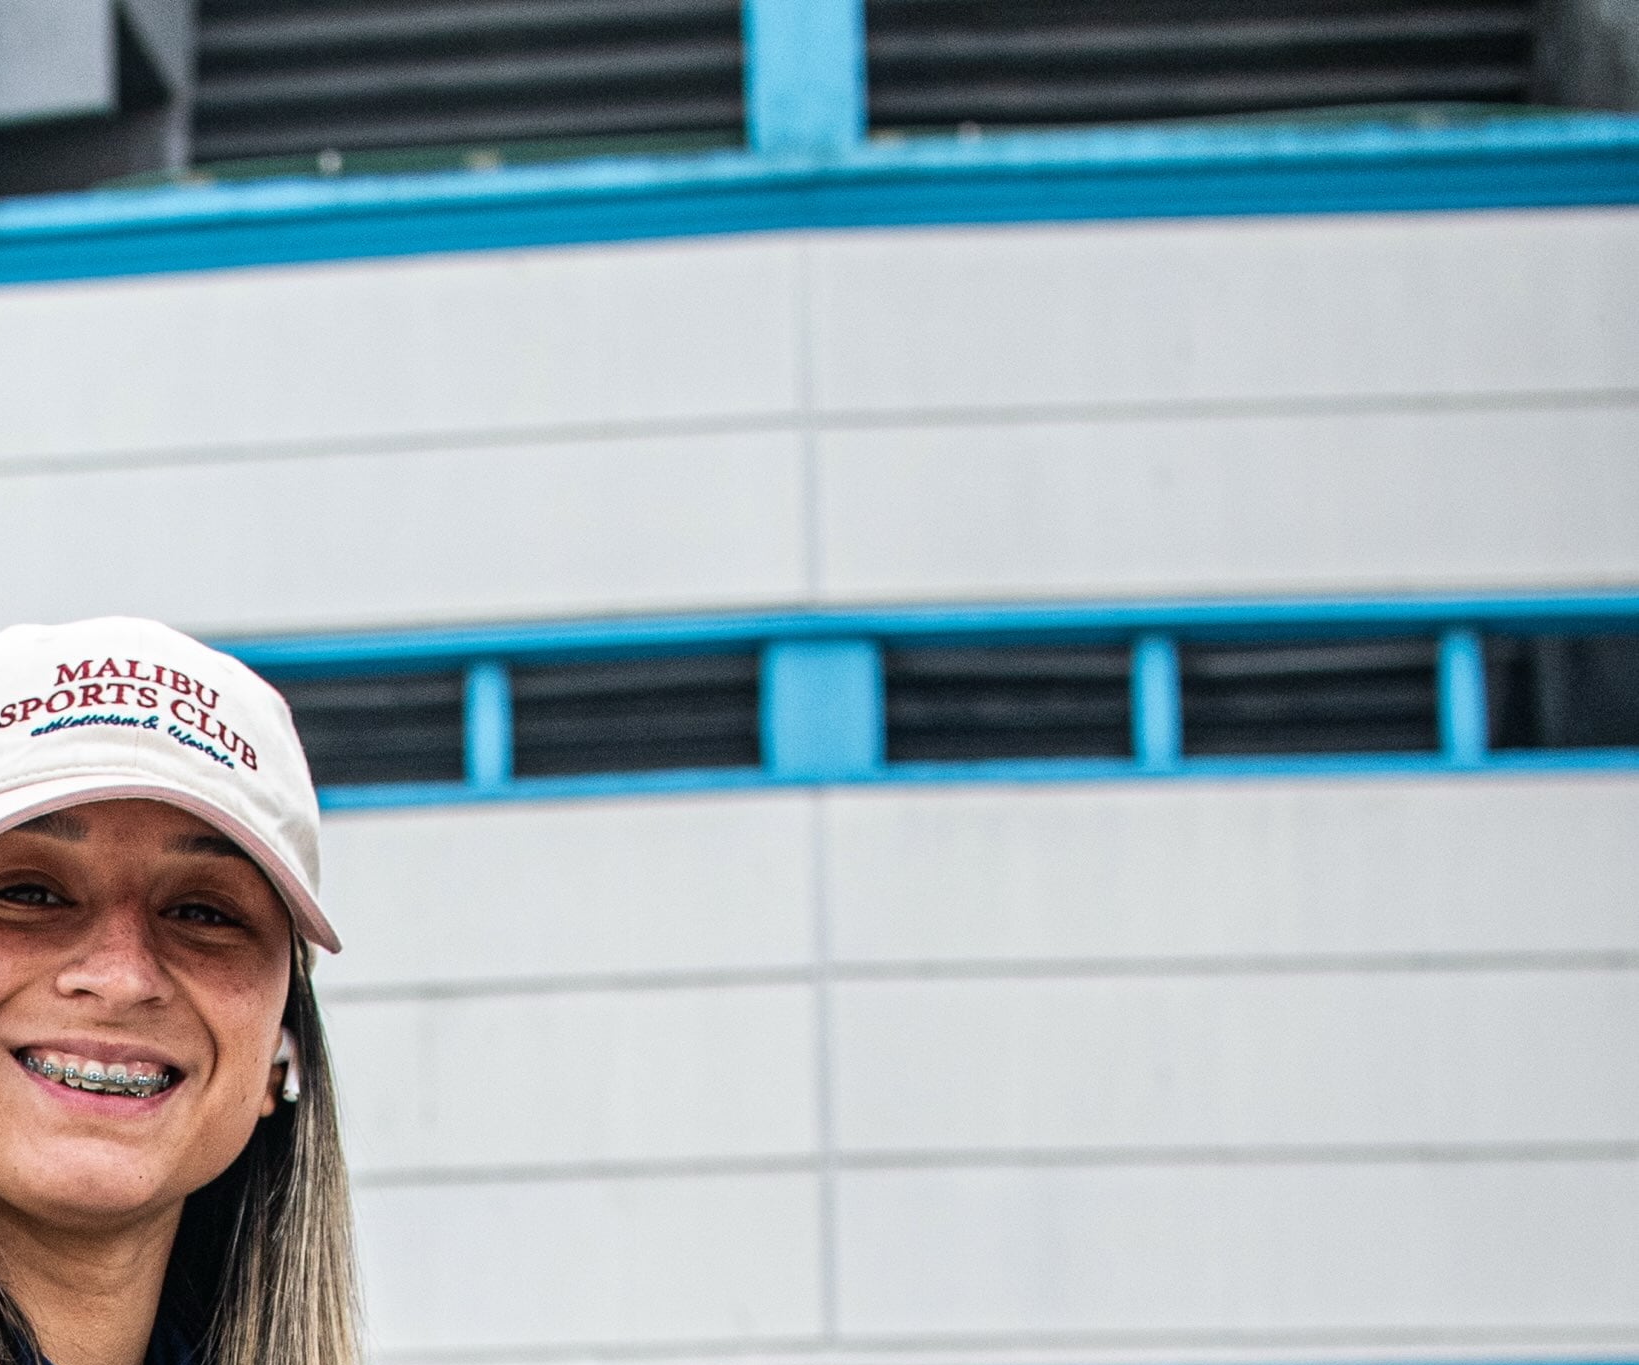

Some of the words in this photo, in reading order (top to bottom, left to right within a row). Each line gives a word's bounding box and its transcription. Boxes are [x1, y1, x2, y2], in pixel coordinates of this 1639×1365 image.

[54, 657, 219, 709] MALIBU
[142, 715, 159, 729] &
[170, 699, 258, 771] CLUB
